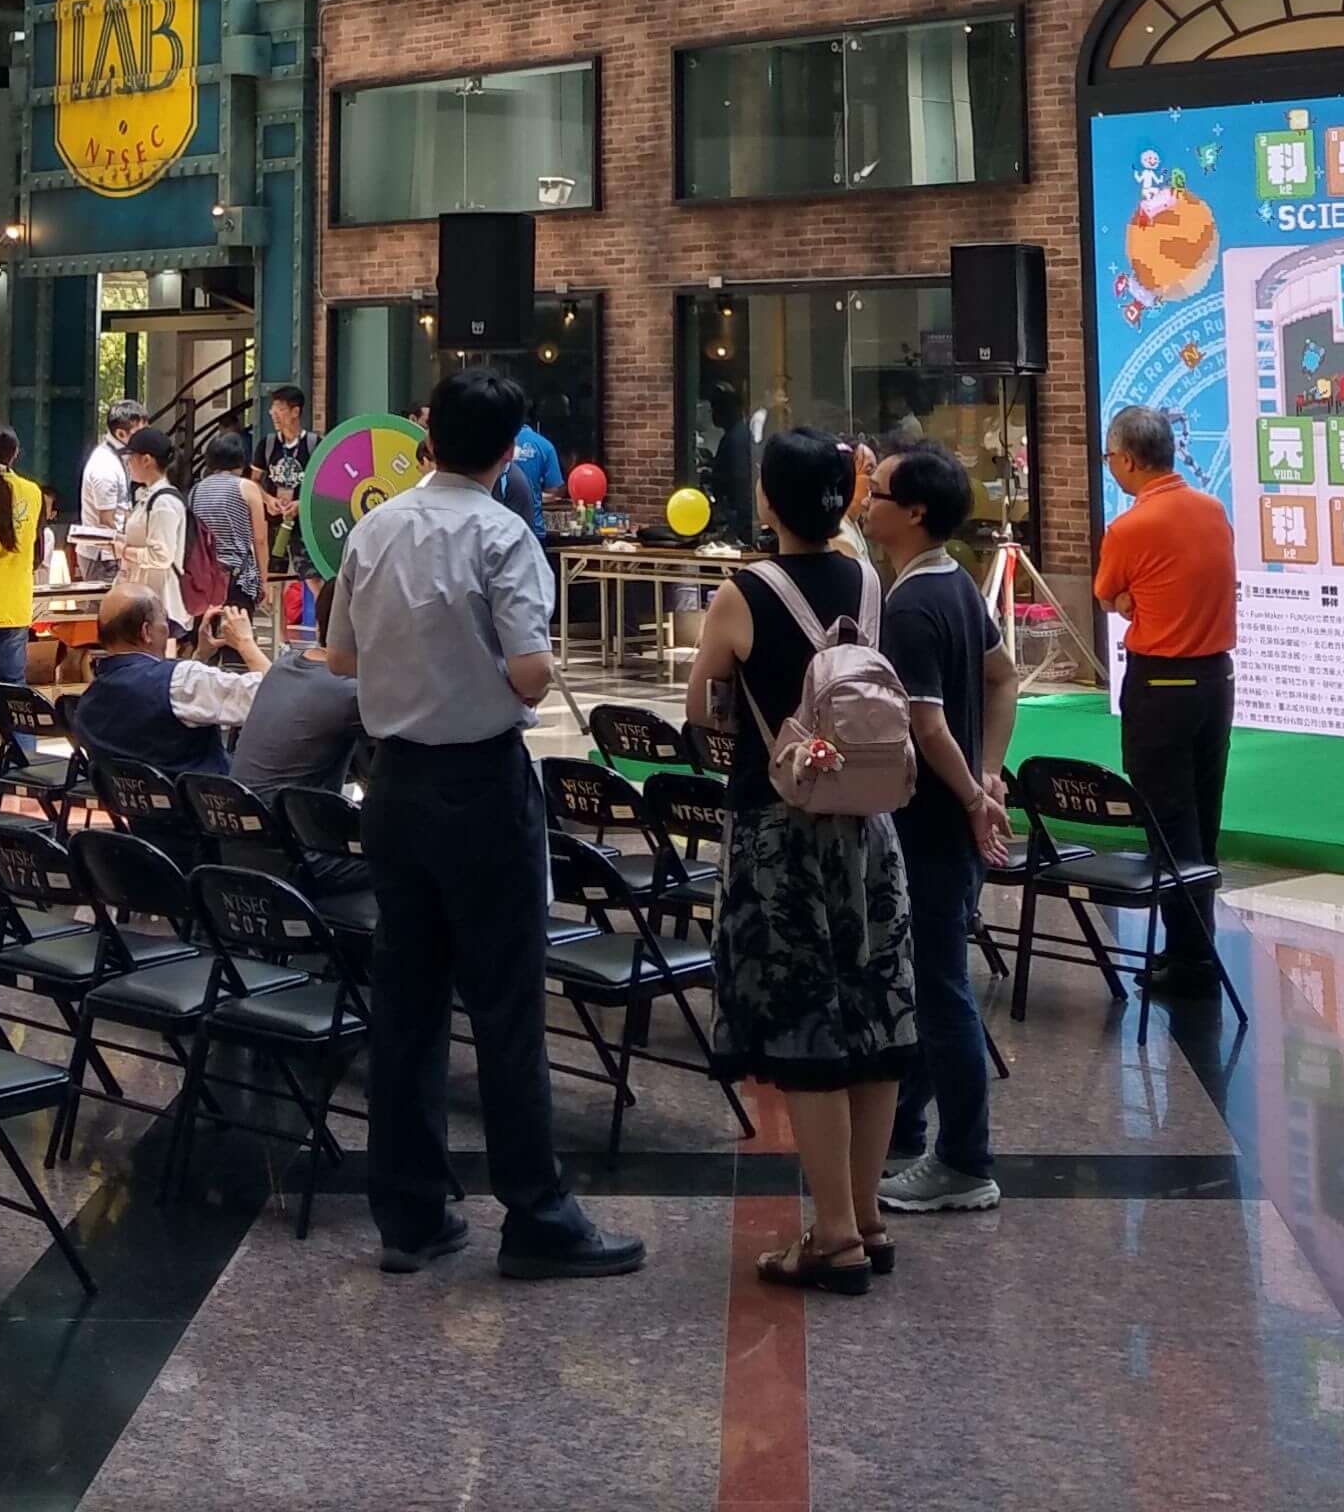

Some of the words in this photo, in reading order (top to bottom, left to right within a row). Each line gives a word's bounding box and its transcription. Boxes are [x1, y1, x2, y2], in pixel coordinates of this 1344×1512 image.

[85, 124, 164, 172] NTSEC
[330, 517, 348, 538] 5
[612, 720, 650, 738] NTSEC
[707, 735, 736, 752] NTSE
[710, 749, 734, 766] 22
[560, 777, 604, 797] NTSEC
[1050, 776, 1099, 797] NTSEC
[670, 802, 724, 825] NTSEC
[221, 890, 272, 916] NTSEC
